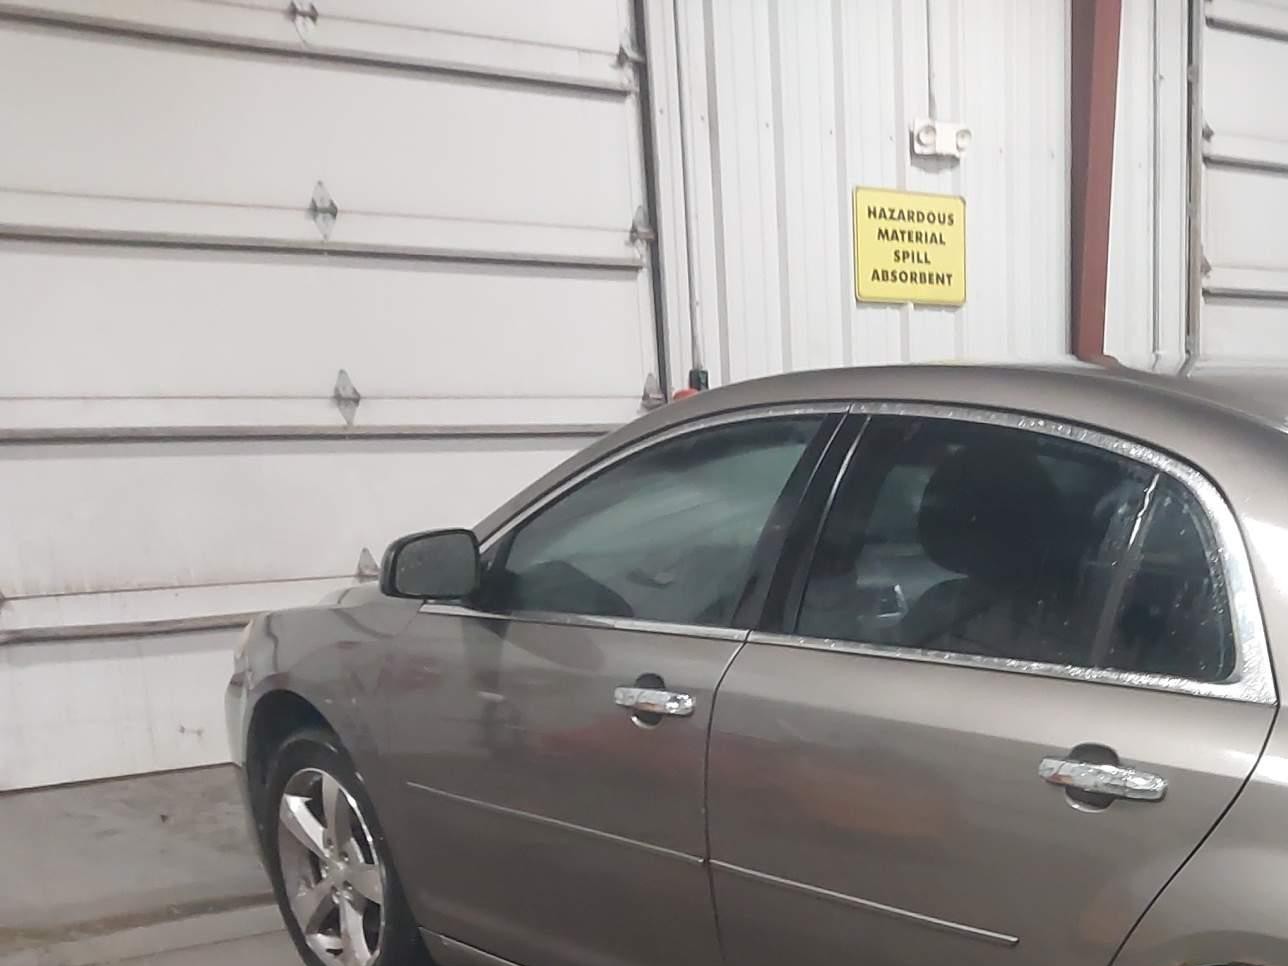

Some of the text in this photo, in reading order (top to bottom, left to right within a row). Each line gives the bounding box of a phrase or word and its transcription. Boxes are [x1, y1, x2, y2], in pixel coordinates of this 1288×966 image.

[867, 205, 955, 226] HAZARDOUS
[877, 227, 946, 245] MATERIAL
[893, 249, 931, 265] SPILL
[871, 268, 953, 286] ABSORBENT
